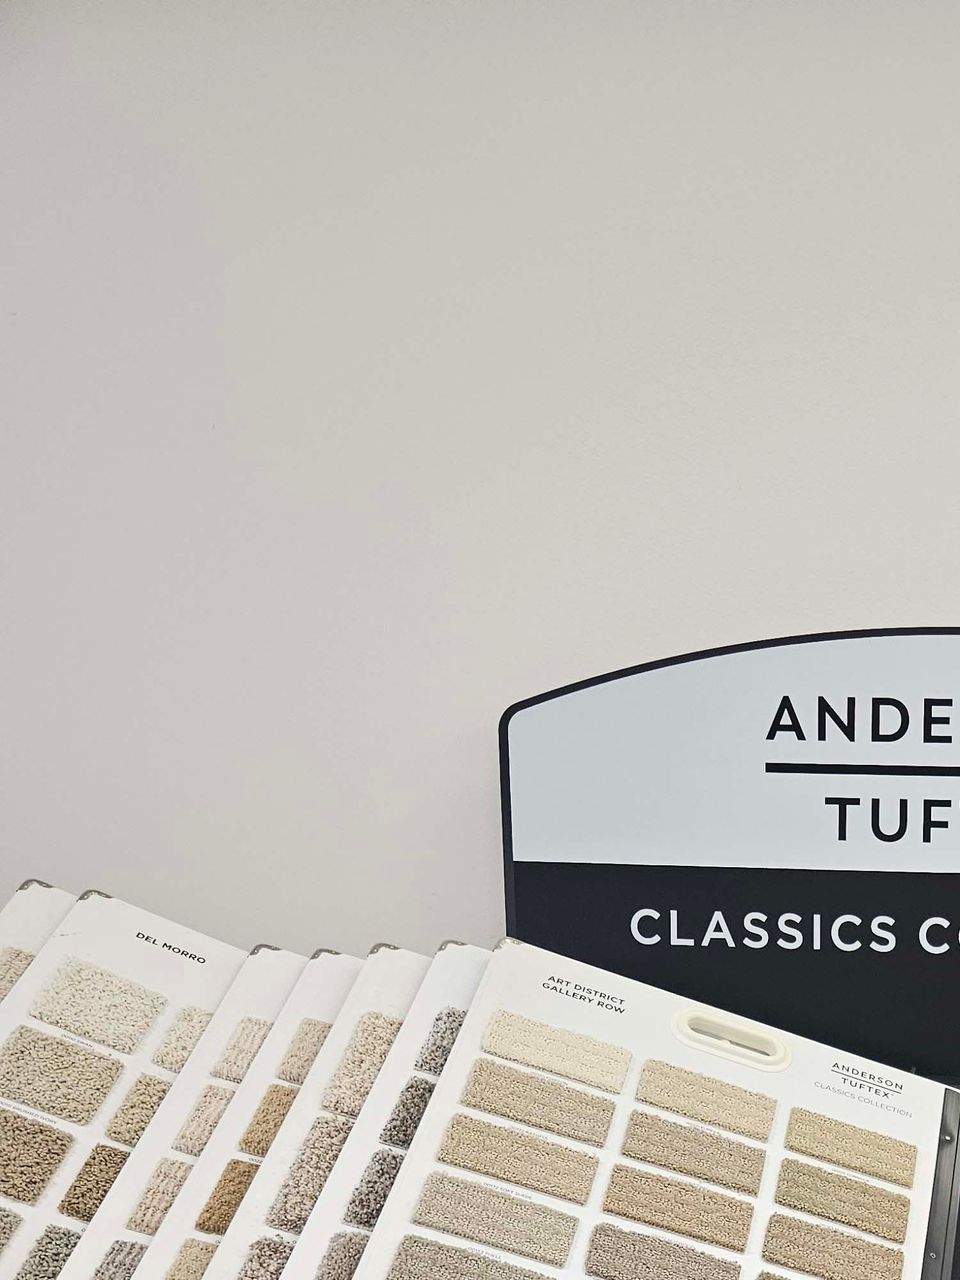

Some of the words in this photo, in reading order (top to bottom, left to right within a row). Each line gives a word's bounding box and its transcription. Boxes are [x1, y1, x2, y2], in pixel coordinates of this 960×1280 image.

[631, 909, 896, 952] CLASSICS
[135, 931, 160, 946] DEL
[162, 941, 207, 965] MORRO
[542, 982, 594, 1003] GALLERY
[596, 1000, 626, 1014] ROW
[548, 975, 571, 987] ART
[574, 983, 626, 1005] DISTRICT
[832, 1062, 904, 1090] ANDERSON
[813, 1081, 856, 1100] CLASSICS
[857, 1095, 913, 1118] COLLECTION
